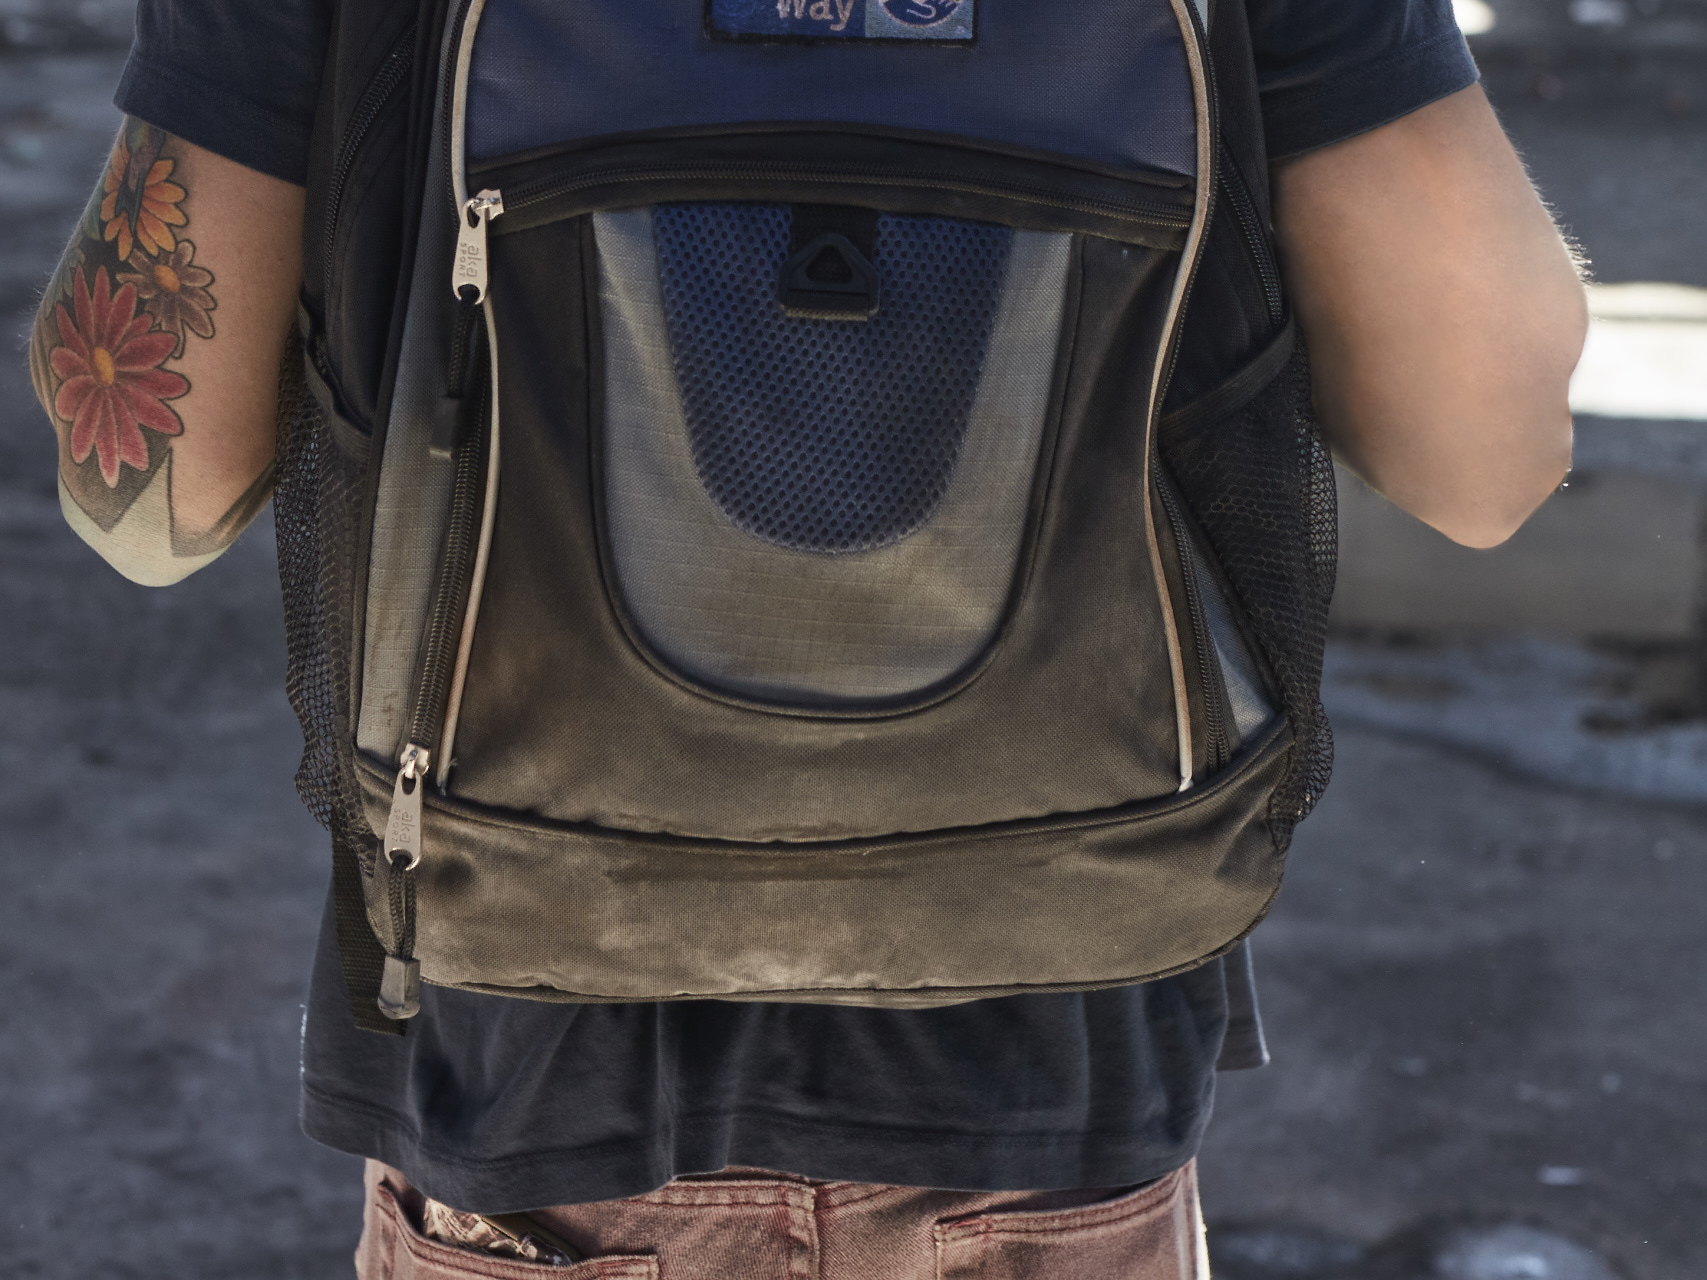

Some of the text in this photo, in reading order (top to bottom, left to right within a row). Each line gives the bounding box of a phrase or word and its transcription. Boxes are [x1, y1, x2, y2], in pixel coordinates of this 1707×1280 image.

[459, 242, 467, 278] SPORT
[466, 245, 483, 278] aka
[391, 808, 401, 842] SPORT
[400, 811, 416, 843] aka
